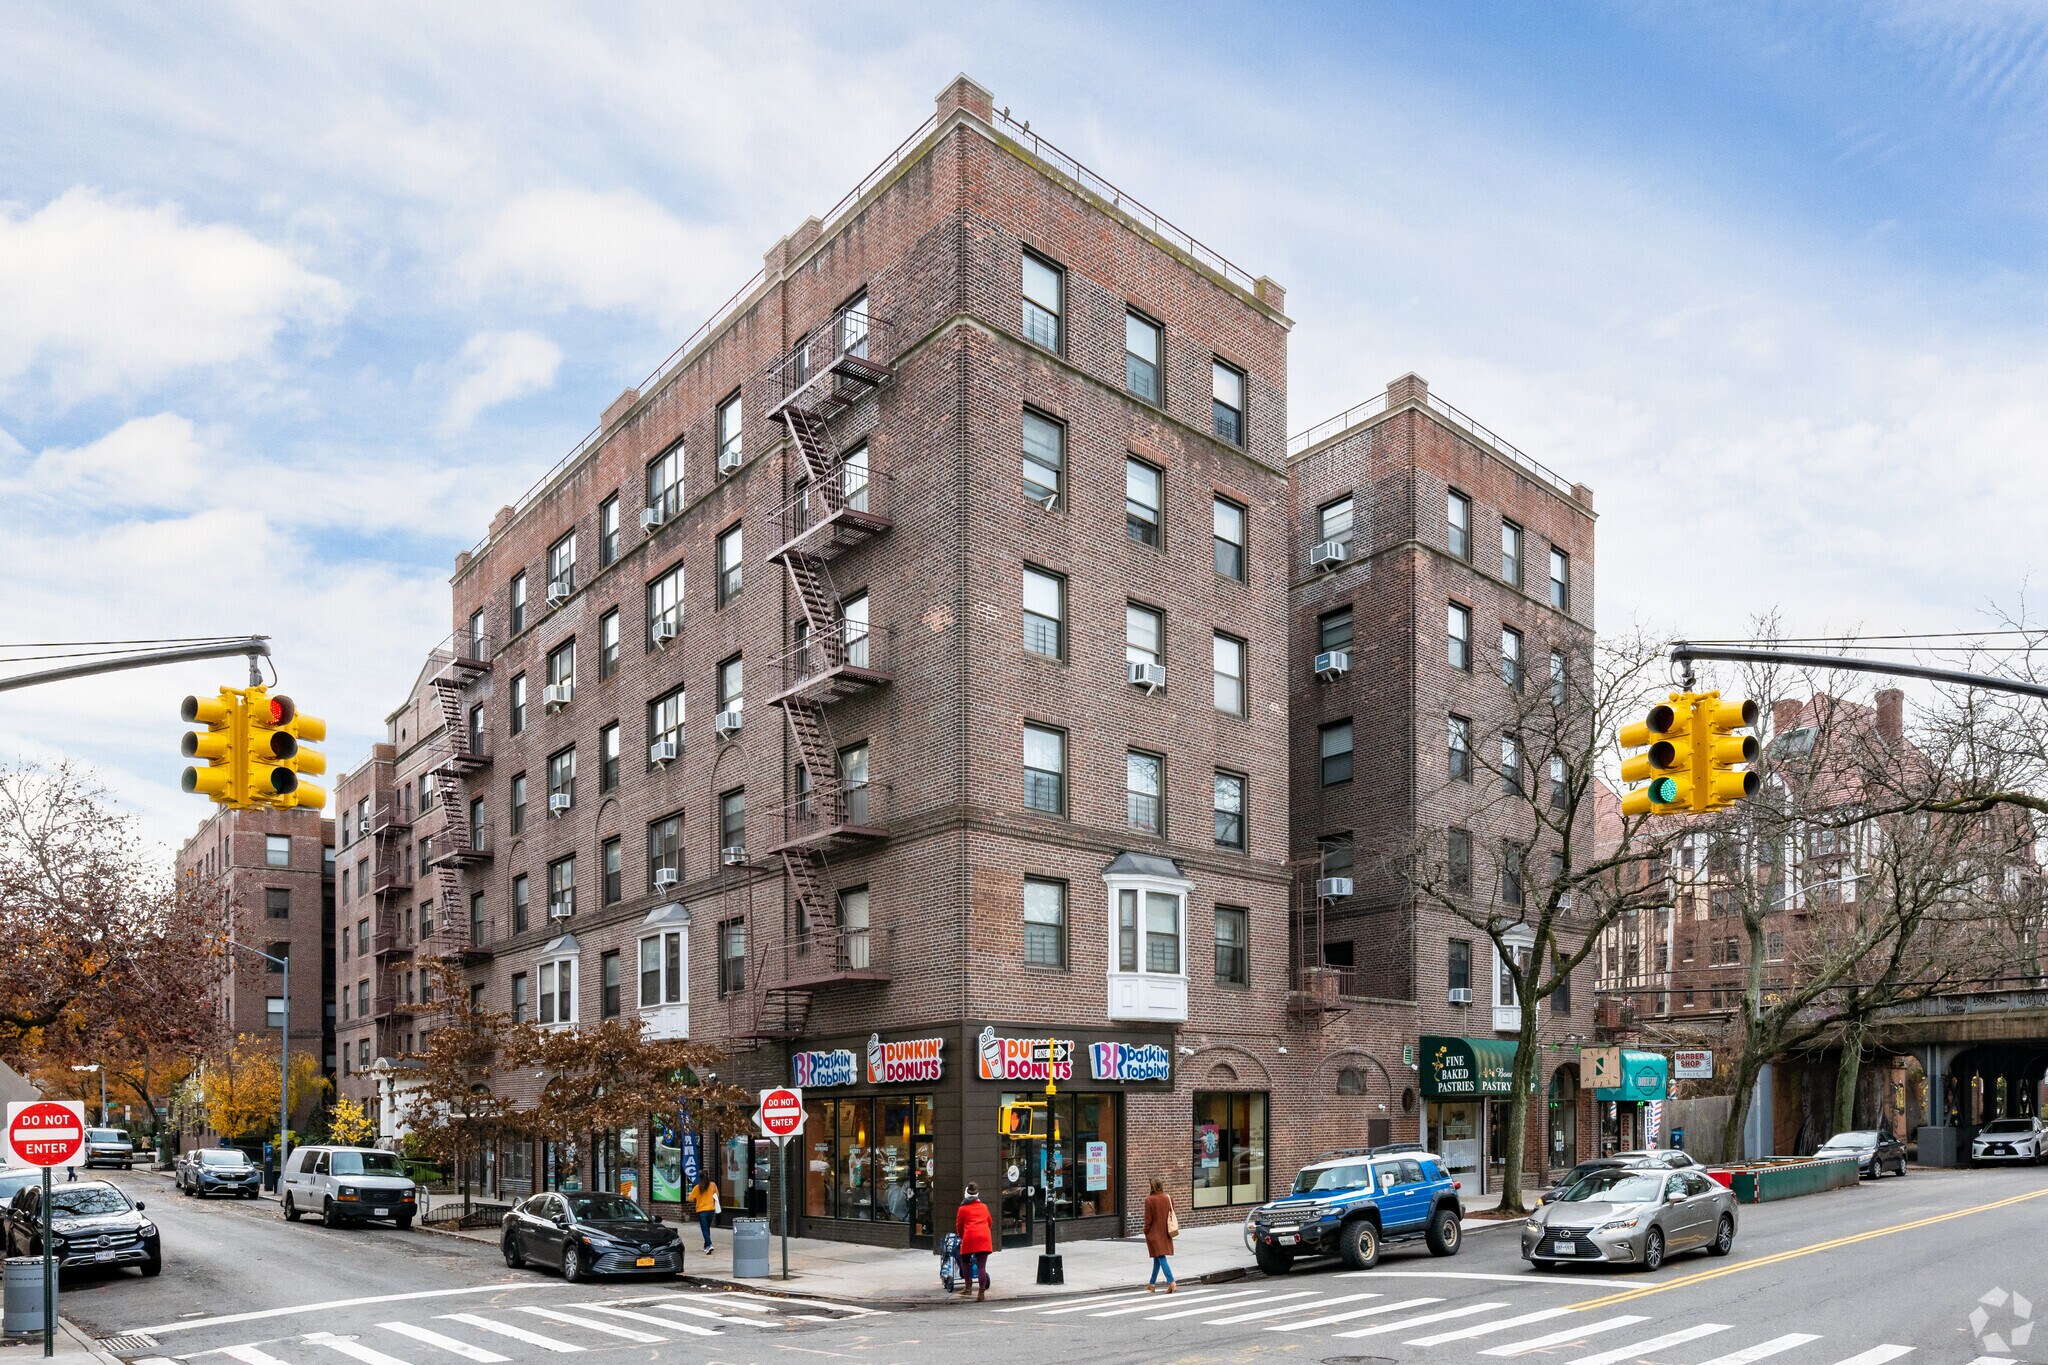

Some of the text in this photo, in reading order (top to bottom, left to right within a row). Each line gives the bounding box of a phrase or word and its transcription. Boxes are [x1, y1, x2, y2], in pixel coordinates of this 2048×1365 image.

[887, 1039, 942, 1061] DUNKIN'
[1036, 1050, 1048, 1058] ONE
[1127, 1044, 1168, 1063] baskin
[817, 1051, 850, 1070] baskin
[1445, 1055, 1465, 1067] FINE
[1680, 1060, 1700, 1068] SHOP
[887, 1059, 939, 1081] DONUTS
[1007, 1060, 1071, 1079] DONUTS
[1127, 1062, 1168, 1079] robbins
[1441, 1068, 1469, 1080] BAKED
[817, 1068, 850, 1086] robbins
[1438, 1081, 1475, 1093] PASTRIES
[1482, 1081, 1512, 1091] PASTRY
[768, 1098, 795, 1107] DO NOT
[22, 1114, 70, 1126] DO NOT
[771, 1118, 794, 1127] ENTER
[26, 1143, 67, 1154] ENTER
